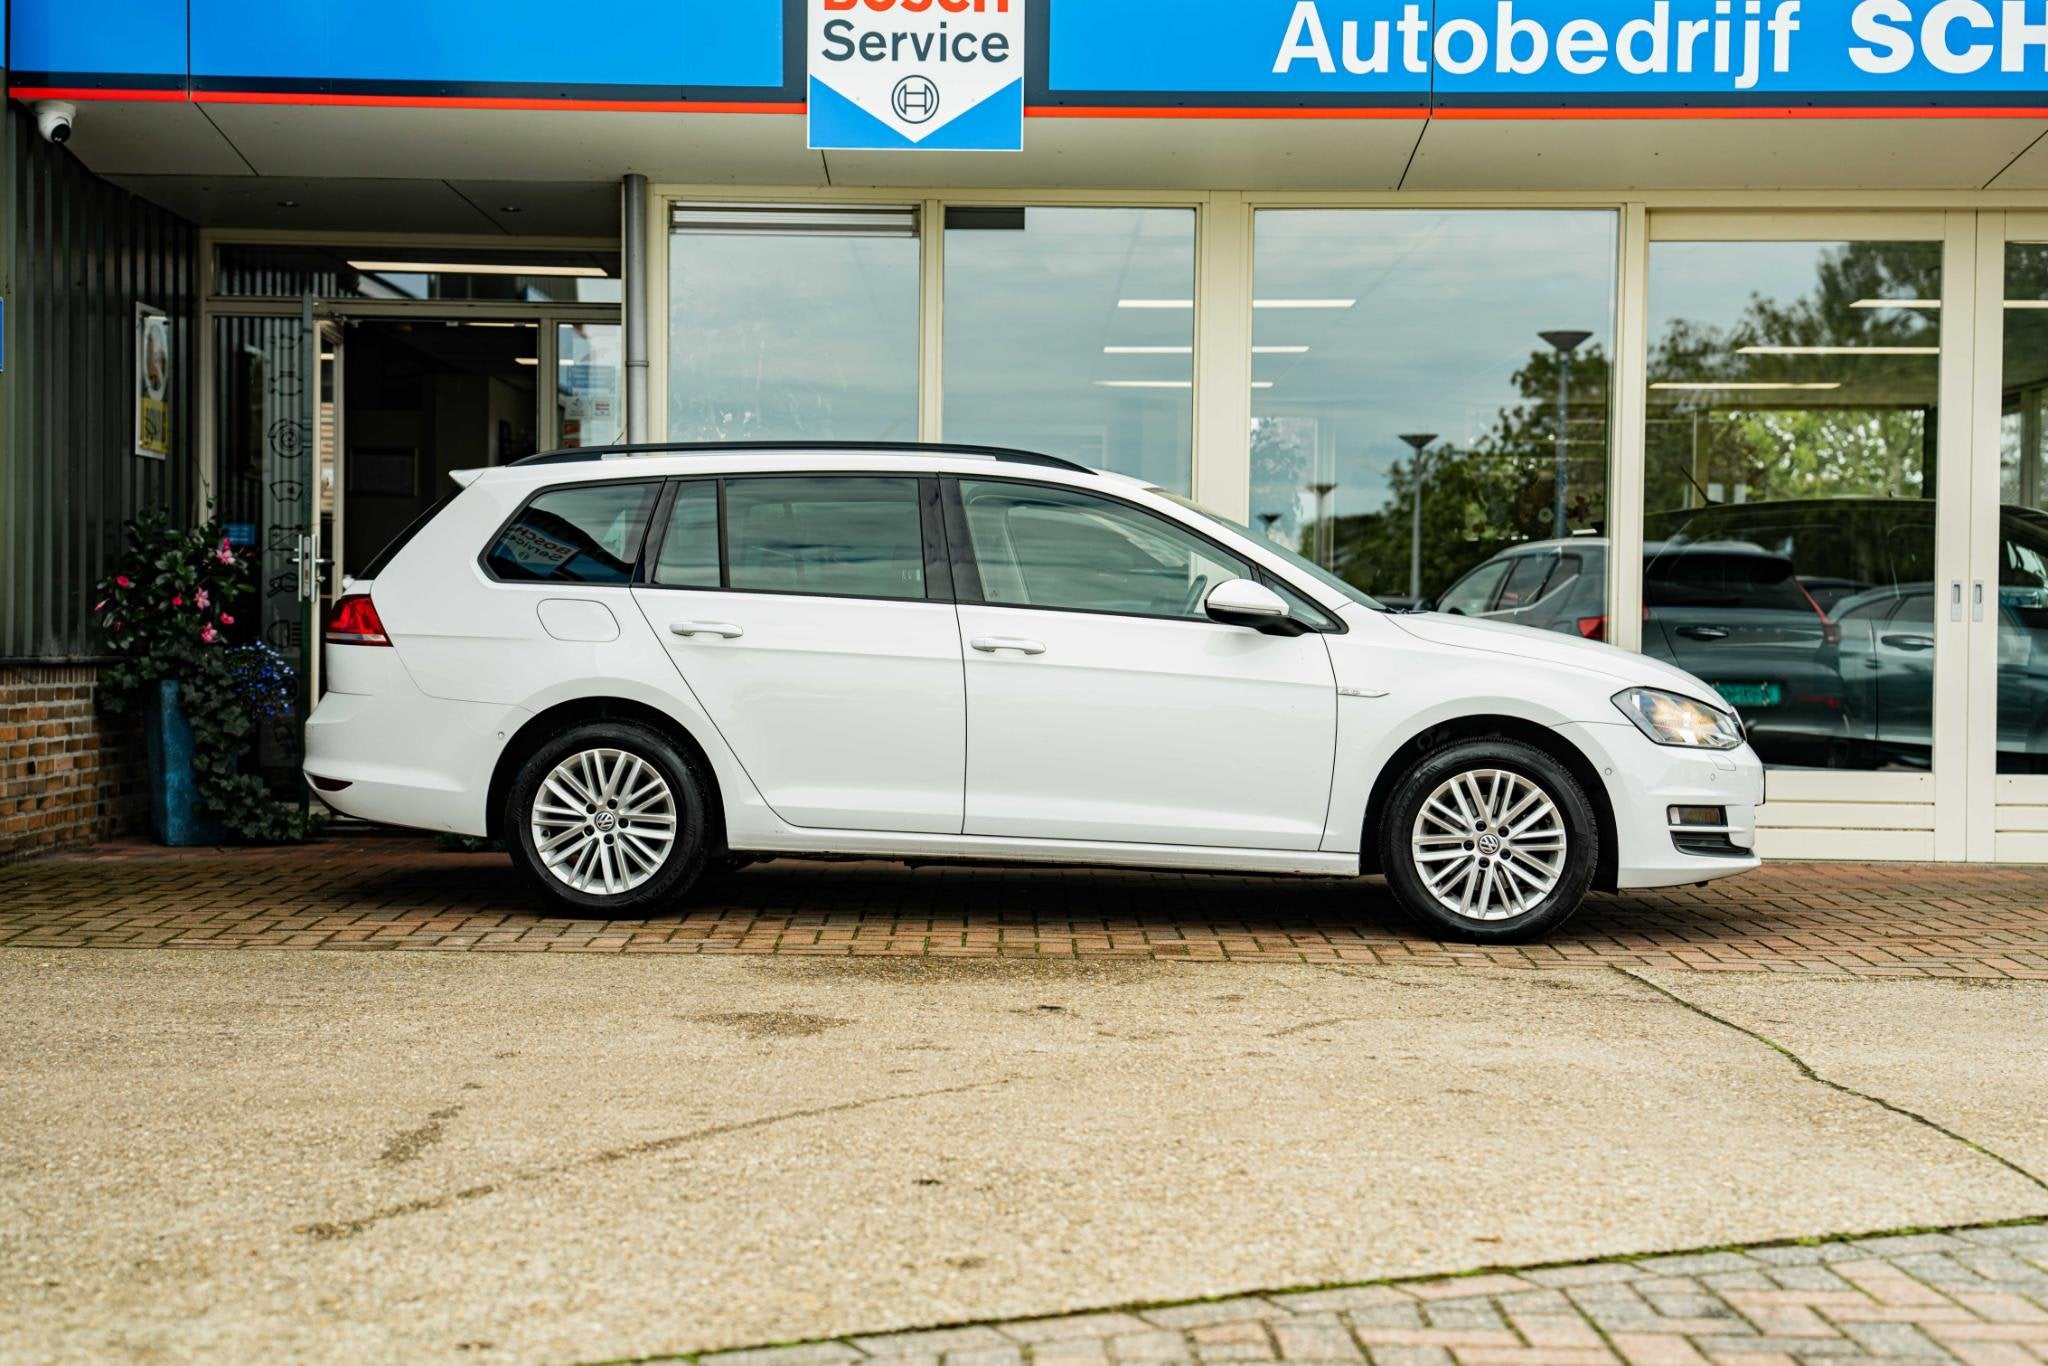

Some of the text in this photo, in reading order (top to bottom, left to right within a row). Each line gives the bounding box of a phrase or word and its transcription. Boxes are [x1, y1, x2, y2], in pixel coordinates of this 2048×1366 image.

[822, 19, 1009, 63] Service
[1272, 0, 2048, 90] Autobedrijf SCH
